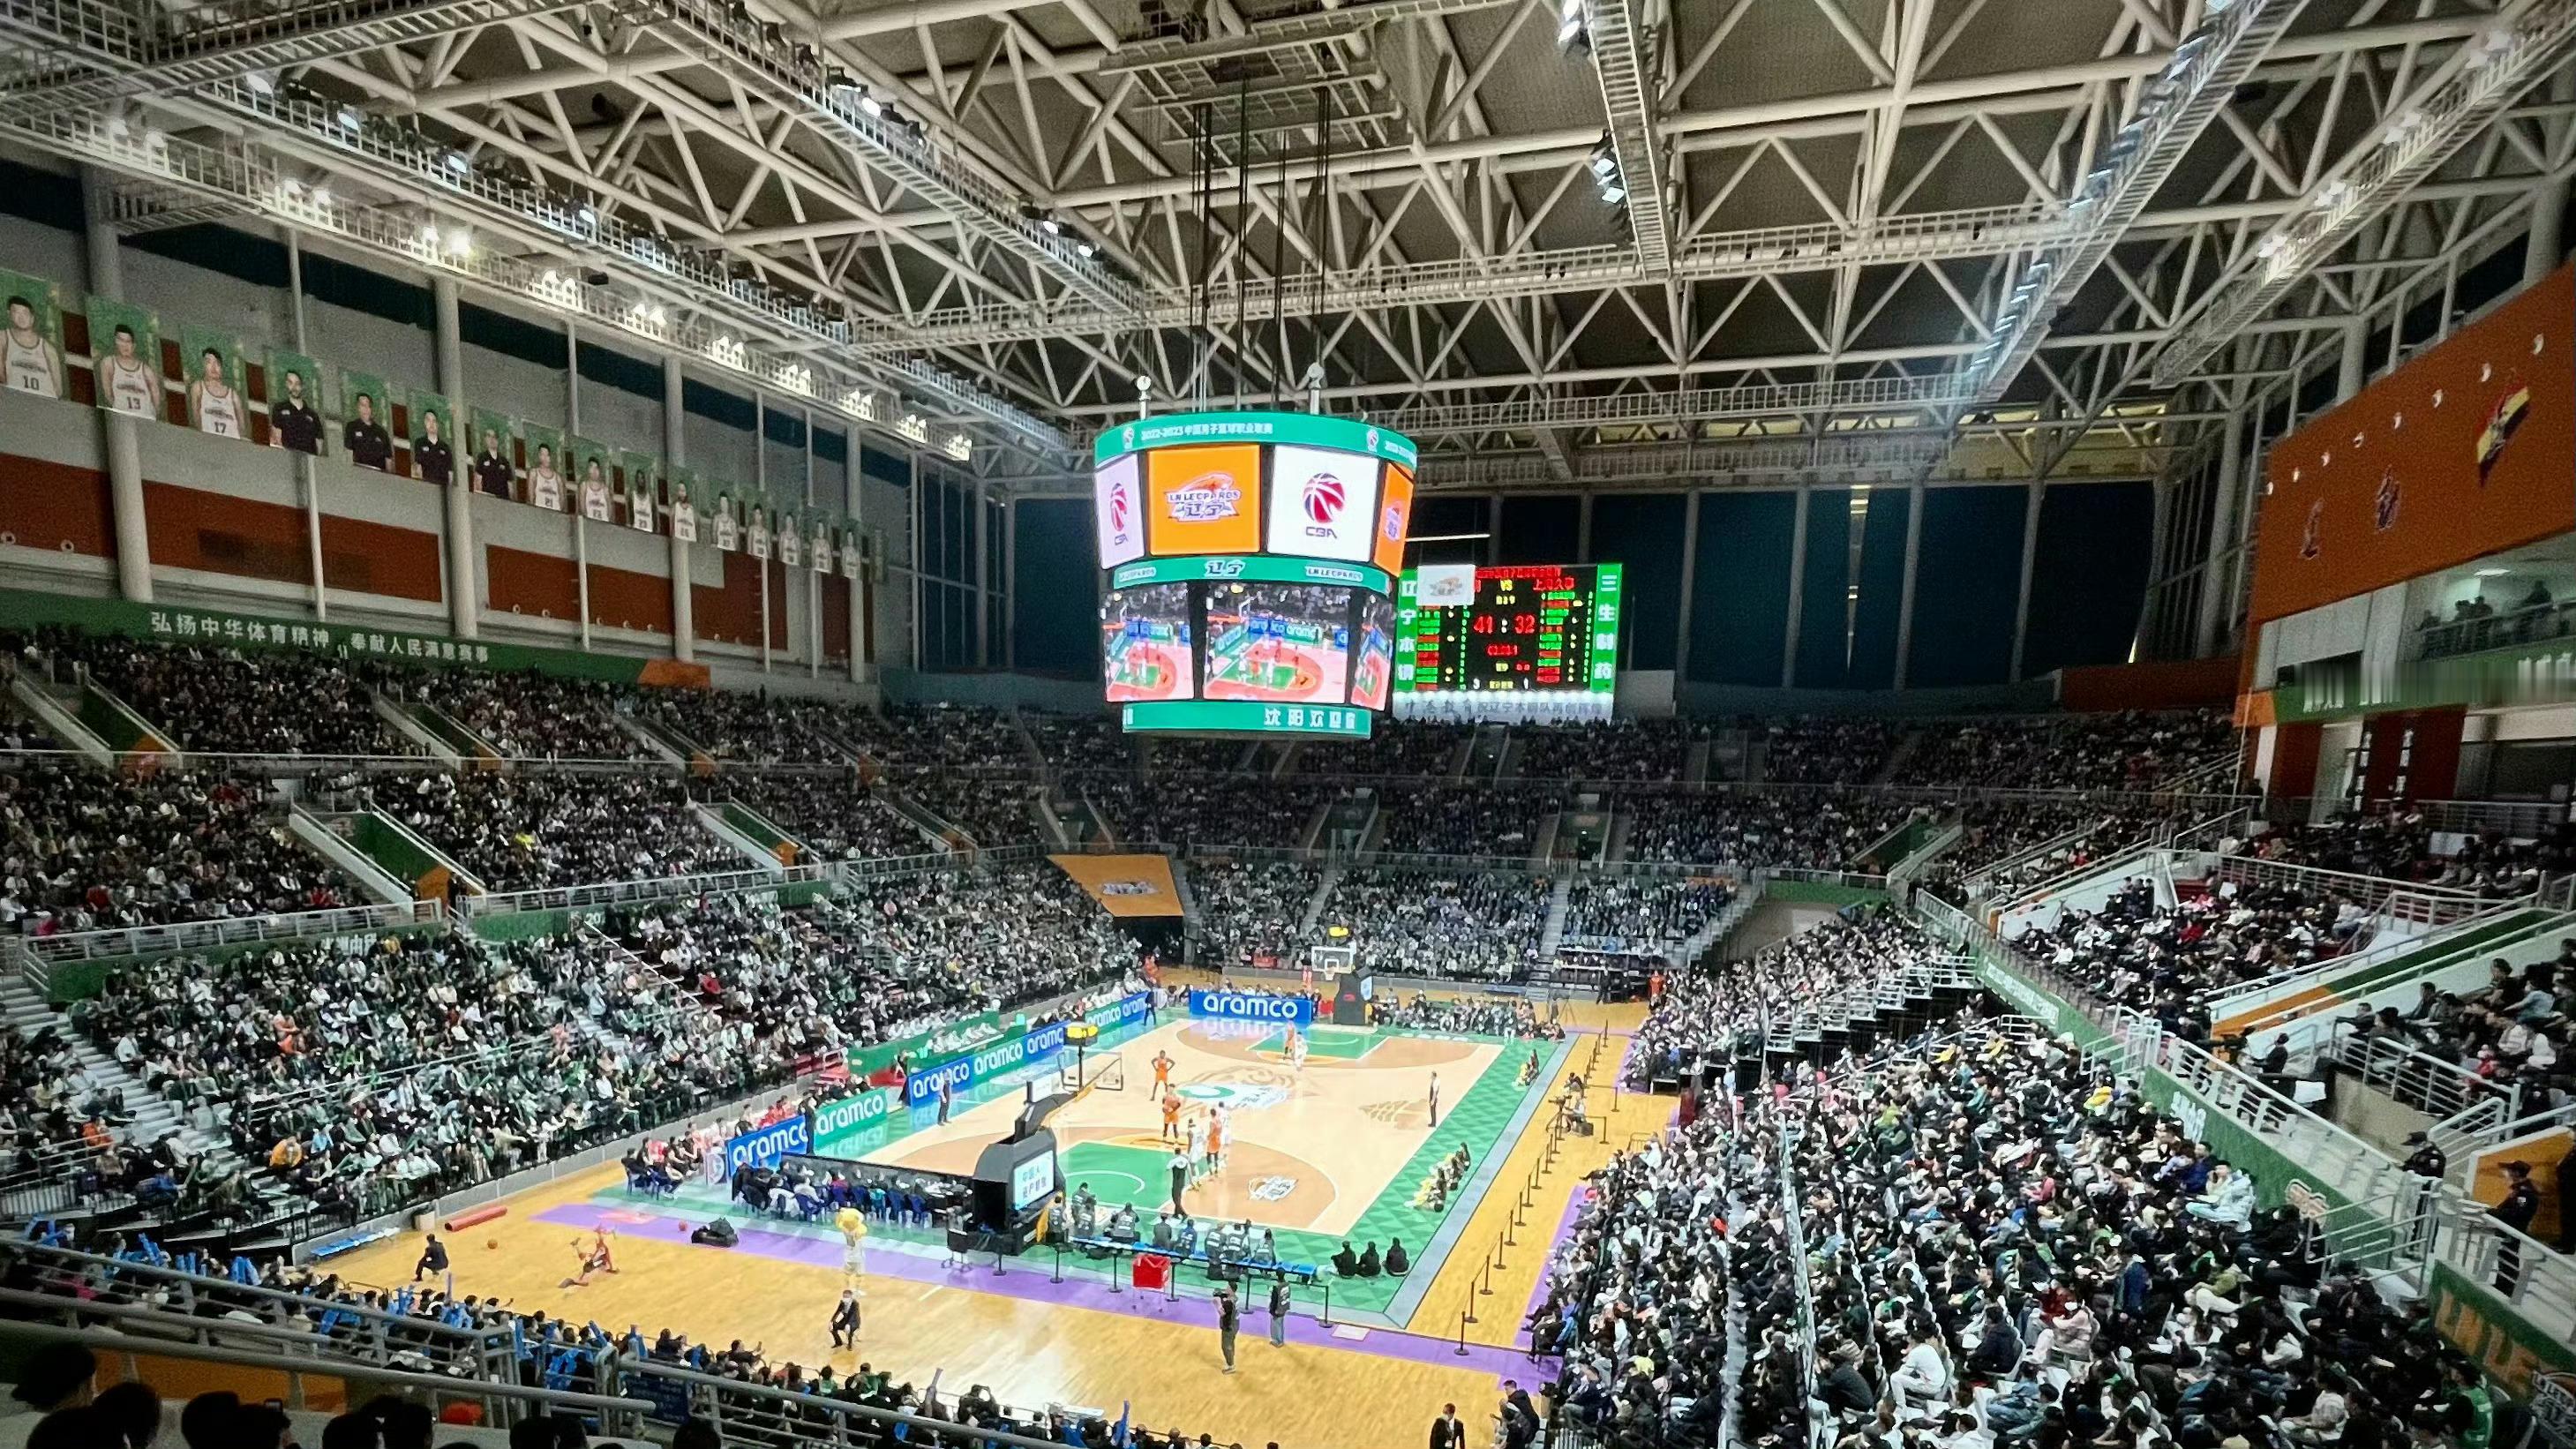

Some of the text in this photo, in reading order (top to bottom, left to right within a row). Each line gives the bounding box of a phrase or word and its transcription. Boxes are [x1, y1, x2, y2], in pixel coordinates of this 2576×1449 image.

[23, 375, 39, 391] 10
[1305, 526, 1338, 539] CBA
[150, 611, 330, 649] 弘扬中华体育精神
[1473, 614, 1536, 634] 41 32
[1203, 994, 1298, 1018] aramco
[1026, 1026, 1064, 1054] aramc
[973, 1040, 1024, 1076] aramco
[815, 1093, 883, 1137] aramco
